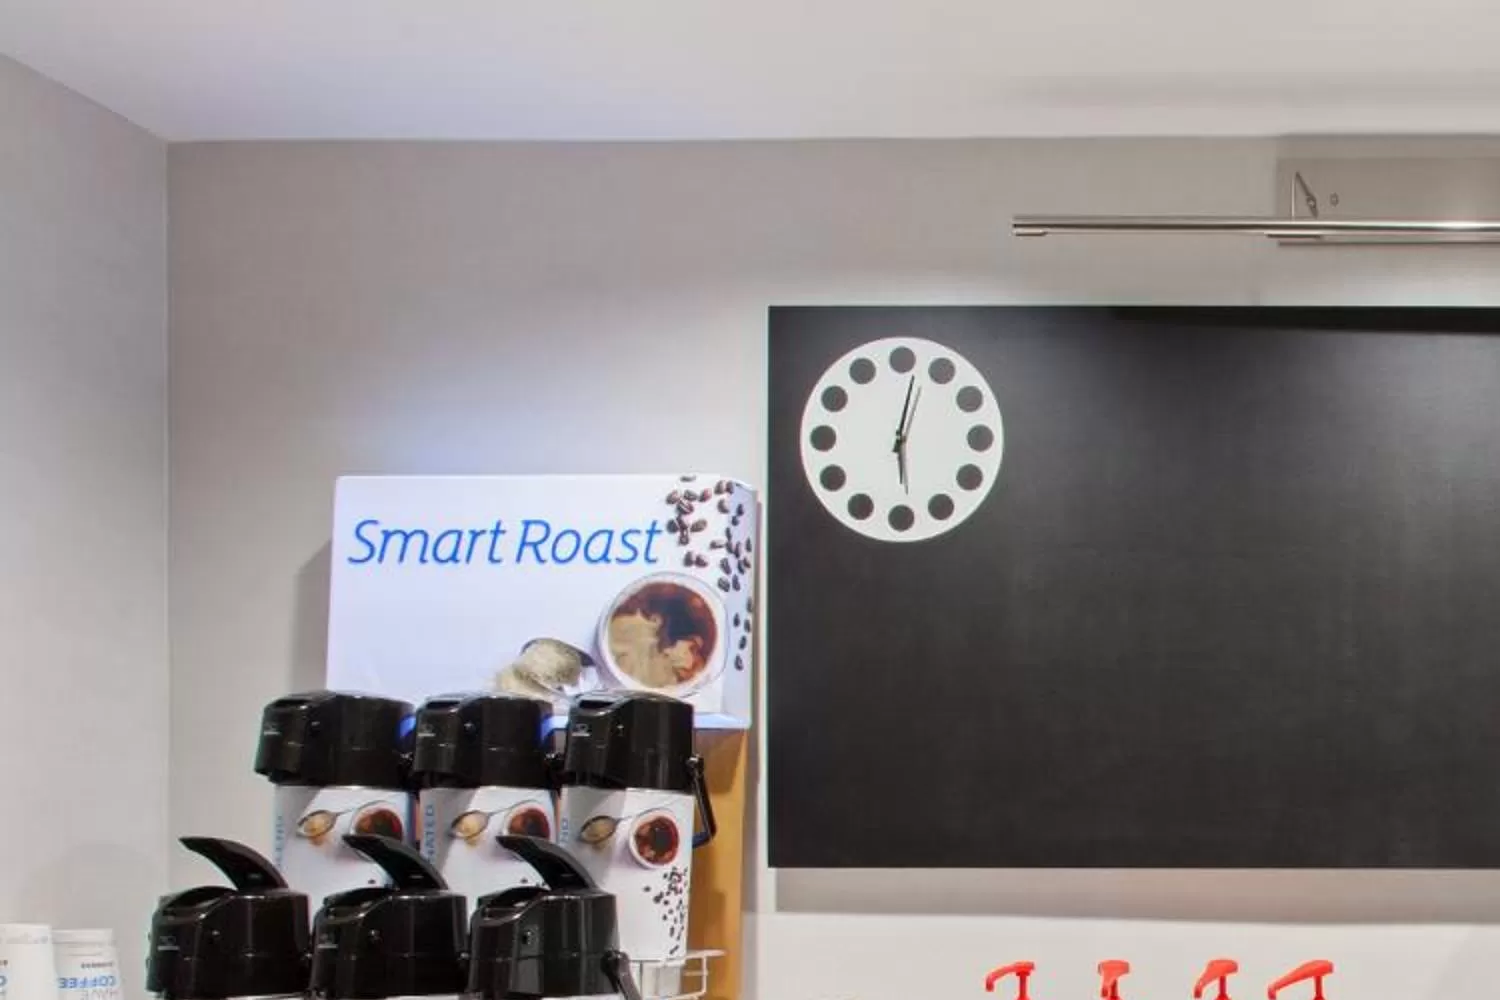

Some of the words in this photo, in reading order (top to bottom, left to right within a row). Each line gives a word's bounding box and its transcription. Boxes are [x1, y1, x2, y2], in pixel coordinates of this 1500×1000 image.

[348, 519, 506, 564] Smart
[516, 519, 663, 564] Roast
[58, 975, 117, 989] COFFEE
